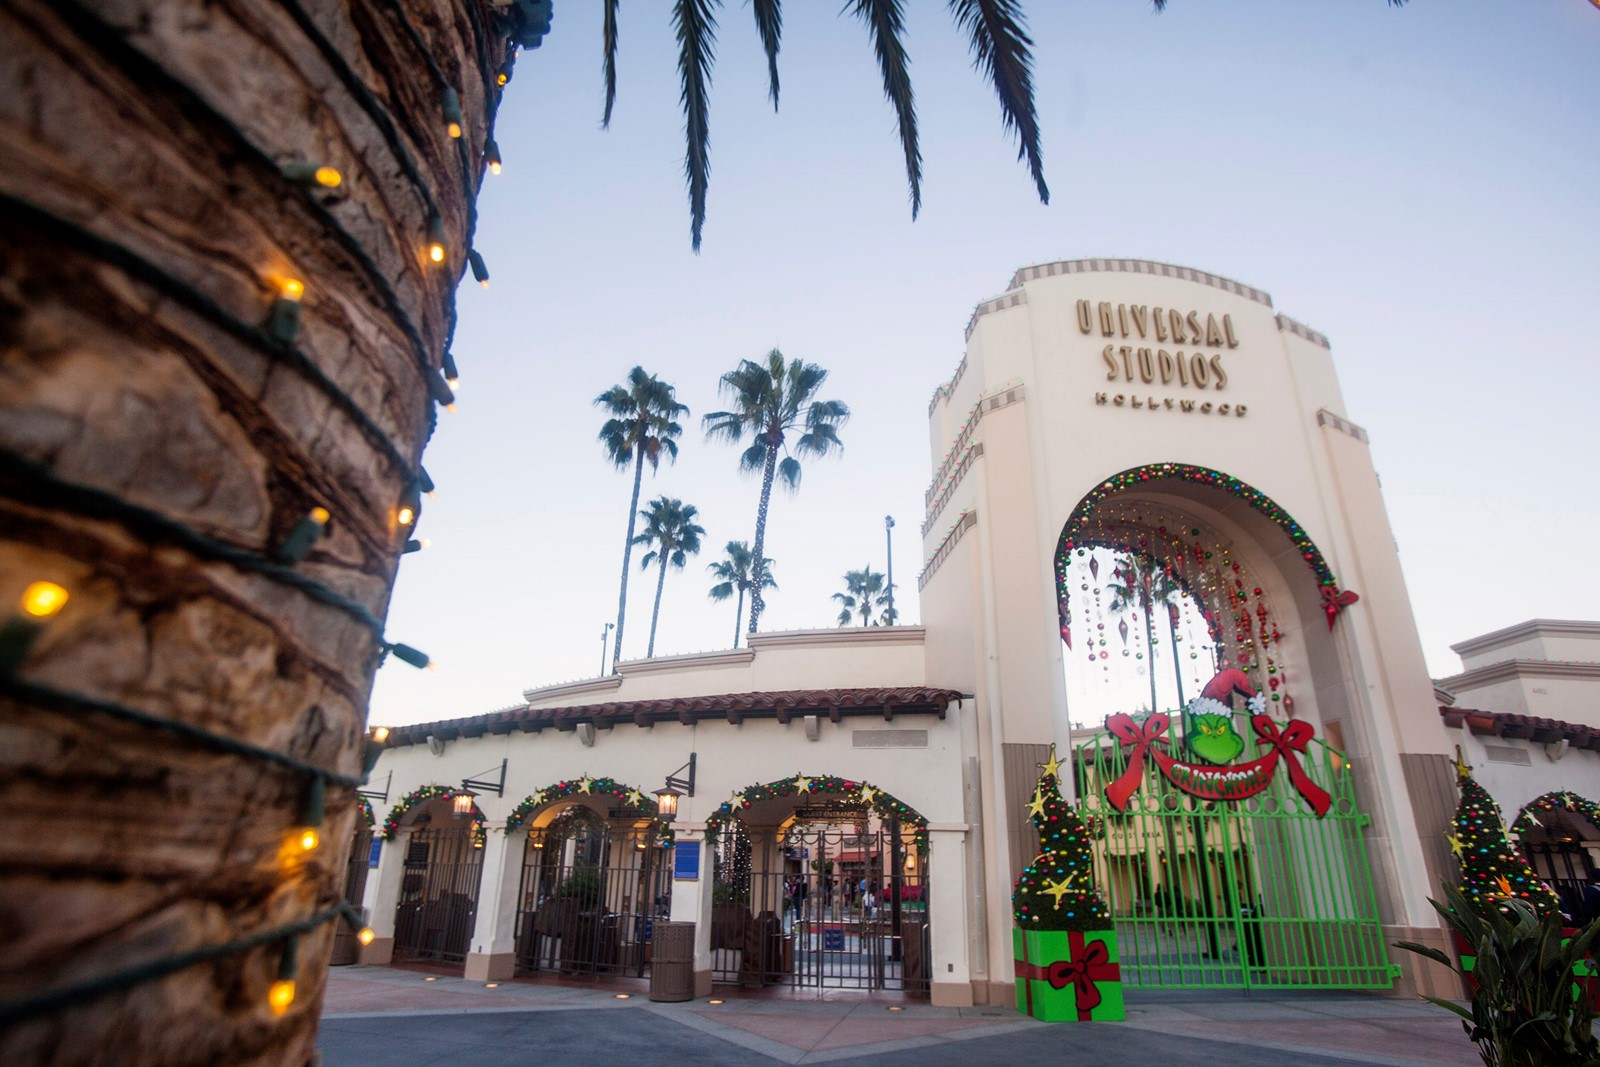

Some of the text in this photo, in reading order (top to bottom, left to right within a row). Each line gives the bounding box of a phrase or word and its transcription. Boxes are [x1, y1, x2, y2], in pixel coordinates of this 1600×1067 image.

[1077, 299, 1239, 349] UNIVERSAL
[1102, 344, 1228, 390] STUDIOS
[1095, 391, 1248, 417] HOLLYWOOD
[1170, 763, 1268, 797] GRINCHMAS
